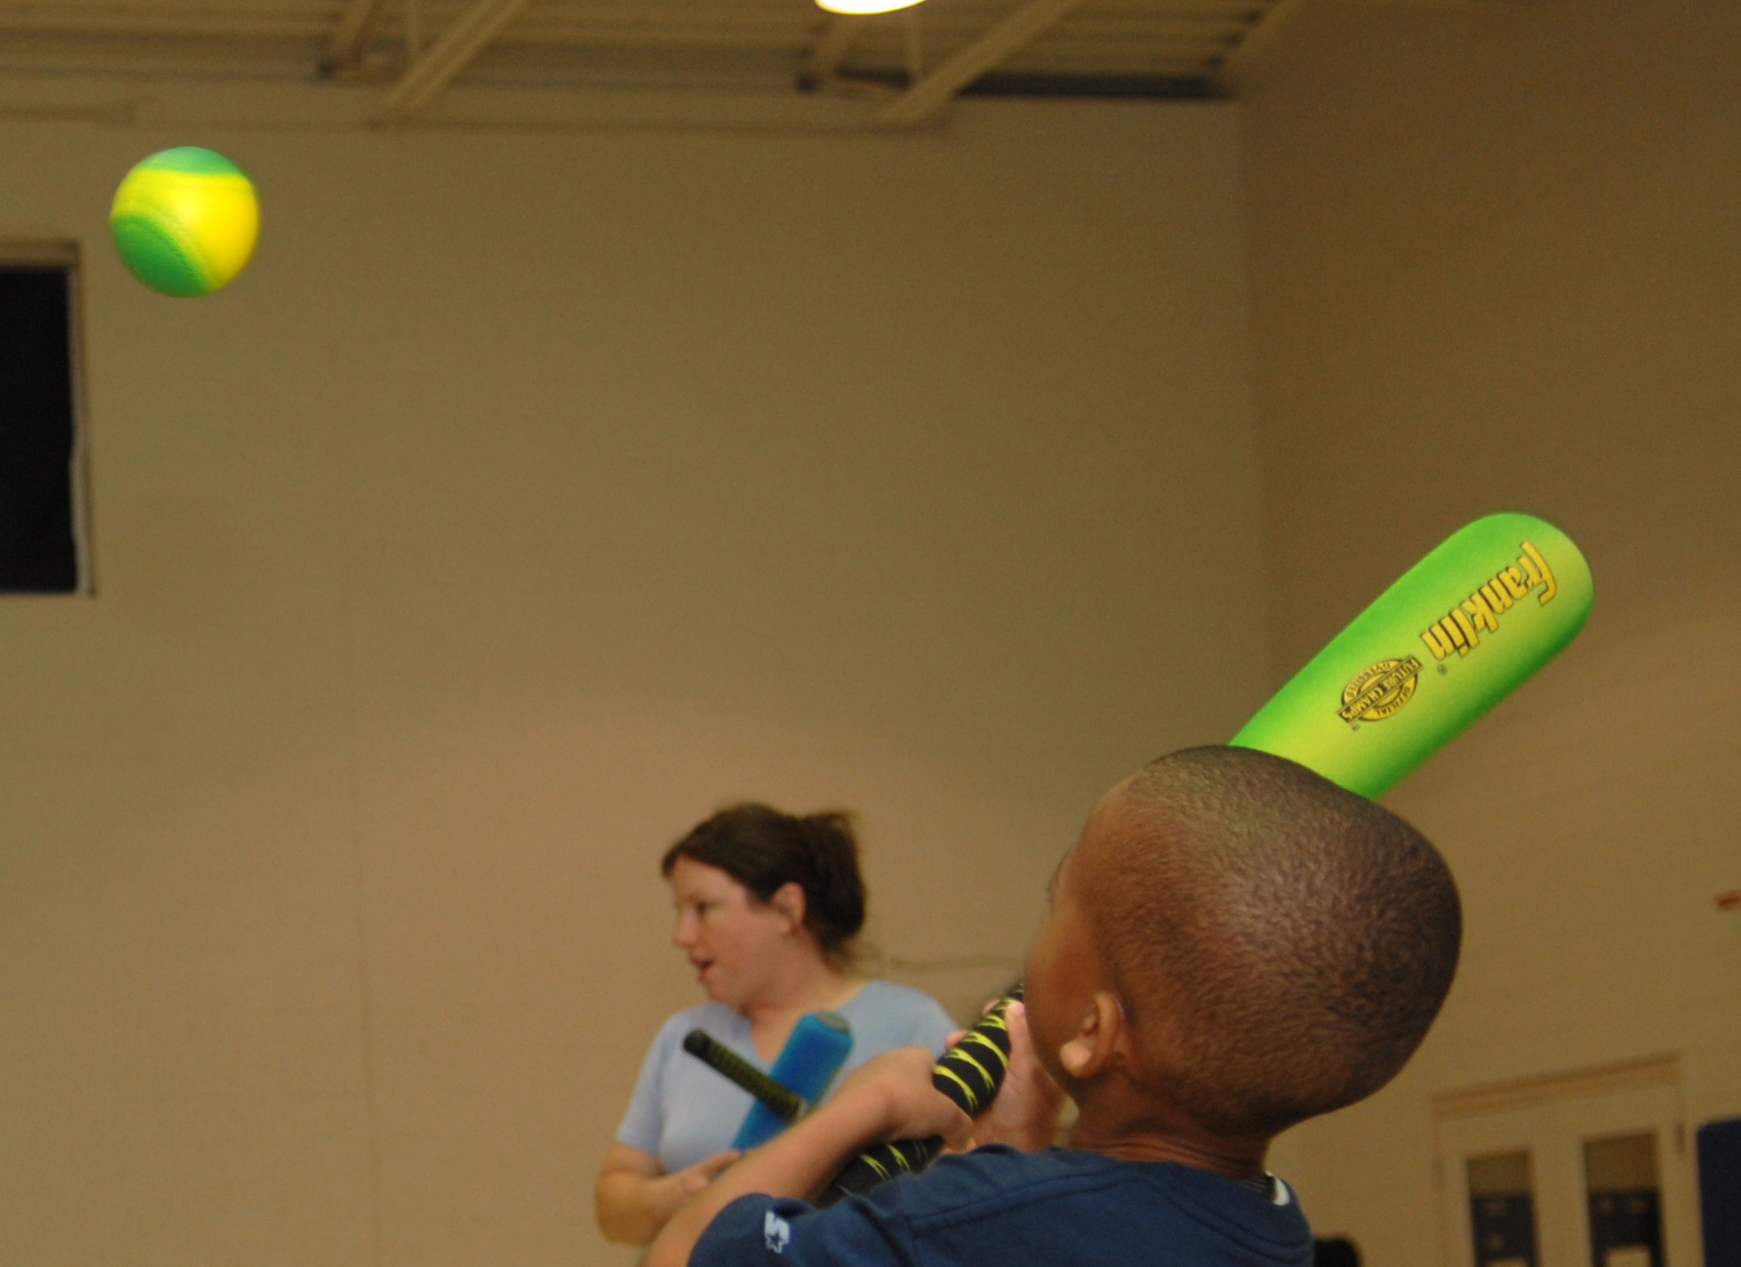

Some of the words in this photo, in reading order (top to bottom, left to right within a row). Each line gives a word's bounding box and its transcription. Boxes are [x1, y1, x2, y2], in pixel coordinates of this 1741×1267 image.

[1382, 658, 1419, 689] FUTURE
[1341, 686, 1384, 720] CHAMPS
[1376, 686, 1410, 716] OFFICIAL
